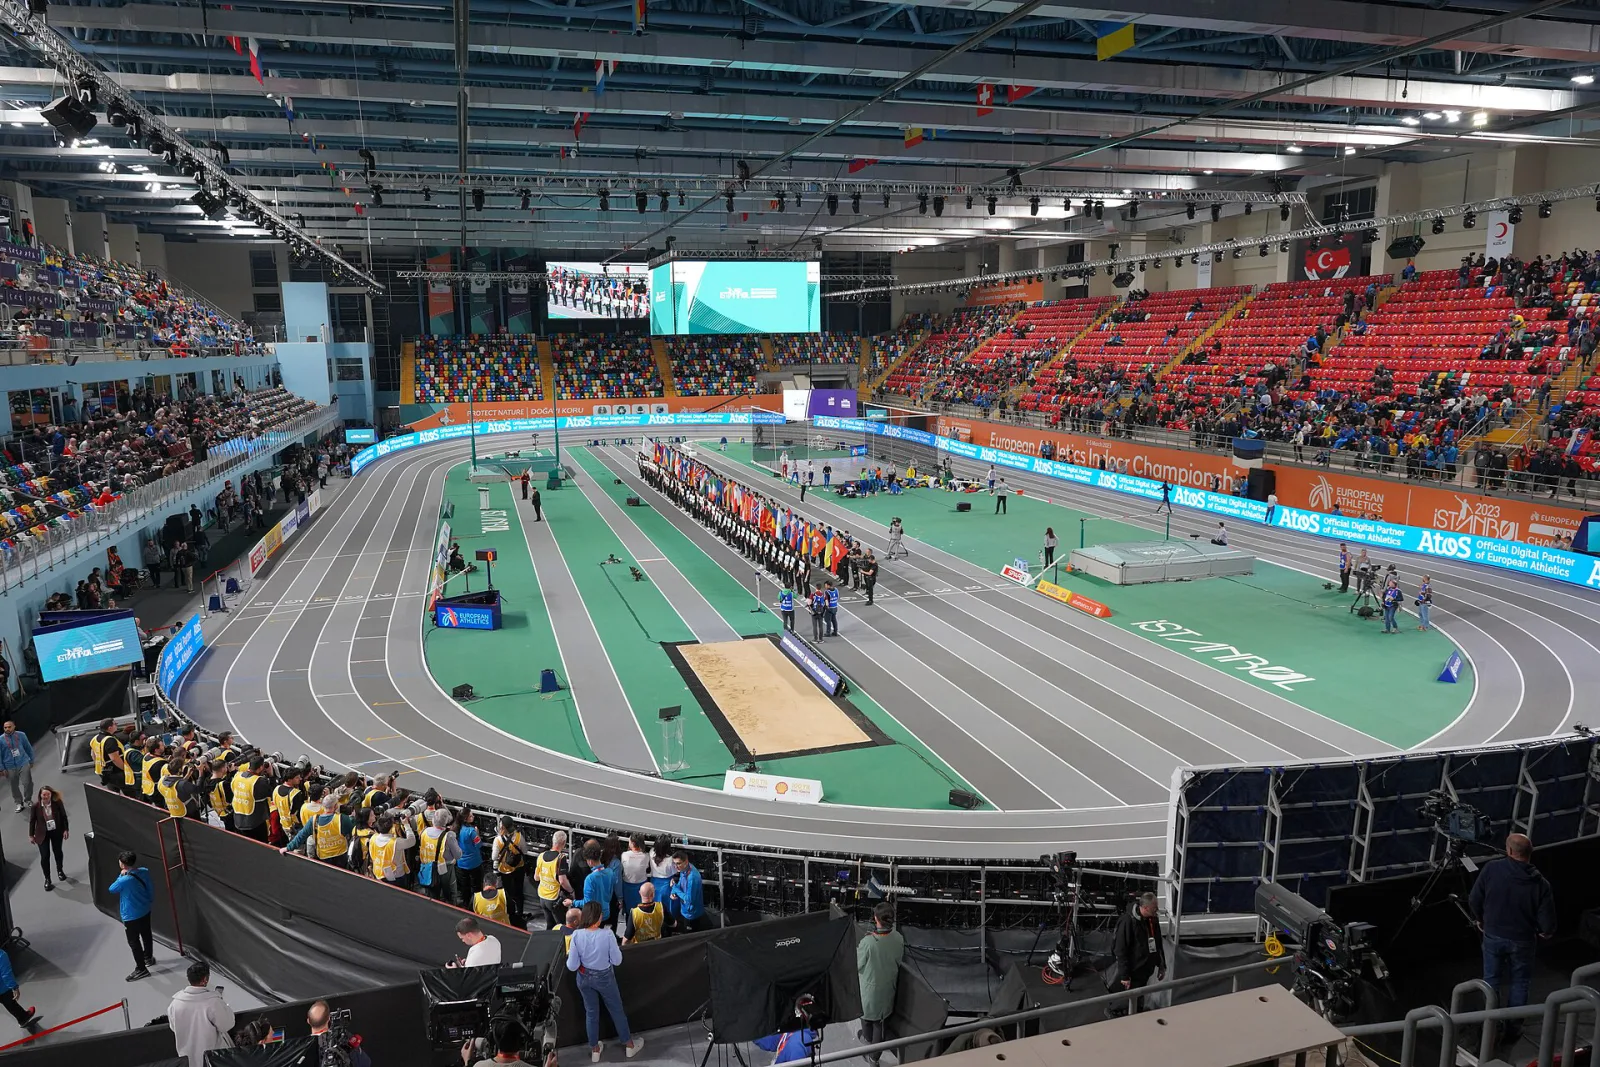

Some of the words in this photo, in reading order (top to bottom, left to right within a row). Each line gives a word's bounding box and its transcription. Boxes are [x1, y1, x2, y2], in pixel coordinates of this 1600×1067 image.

[565, 416, 591, 428] Atos
[648, 414, 674, 424] Atos
[729, 414, 748, 423] Atos
[487, 422, 512, 433] Atos
[883, 425, 902, 437] Atos
[419, 430, 440, 444] Atos
[934, 436, 949, 450] Atos
[990, 432, 1035, 454] European
[980, 448, 996, 462] Atos
[1033, 458, 1052, 474] Atos
[1119, 476, 1134, 485] Official
[1136, 479, 1150, 488] Digital
[1124, 485, 1144, 495] European
[1336, 487, 1384, 503] EUROPEAN
[1174, 488, 1205, 508] Atos
[1208, 495, 1227, 503] Official
[1229, 498, 1247, 508] Digital
[1248, 502, 1267, 512] Partne
[1336, 497, 1383, 512] ATHLETICS
[1214, 504, 1240, 515] European
[1475, 503, 1500, 518] 2023
[1278, 508, 1320, 533] Atos
[1323, 517, 1349, 528] Official
[1352, 520, 1374, 532] Digital
[1376, 523, 1406, 536] Partner
[1541, 515, 1581, 527] EUROPEAN
[1332, 528, 1365, 540] European
[1367, 534, 1401, 546] Athletics
[1417, 531, 1471, 558] Atos
[1477, 540, 1508, 554] Official
[1512, 544, 1539, 560] Digital
[1542, 551, 1575, 567] Partner
[1487, 553, 1528, 569] European
[1530, 560, 1570, 577] Athletics
[1008, 569, 1022, 581] SPAR
[319, 840, 342, 848] PHOTO
